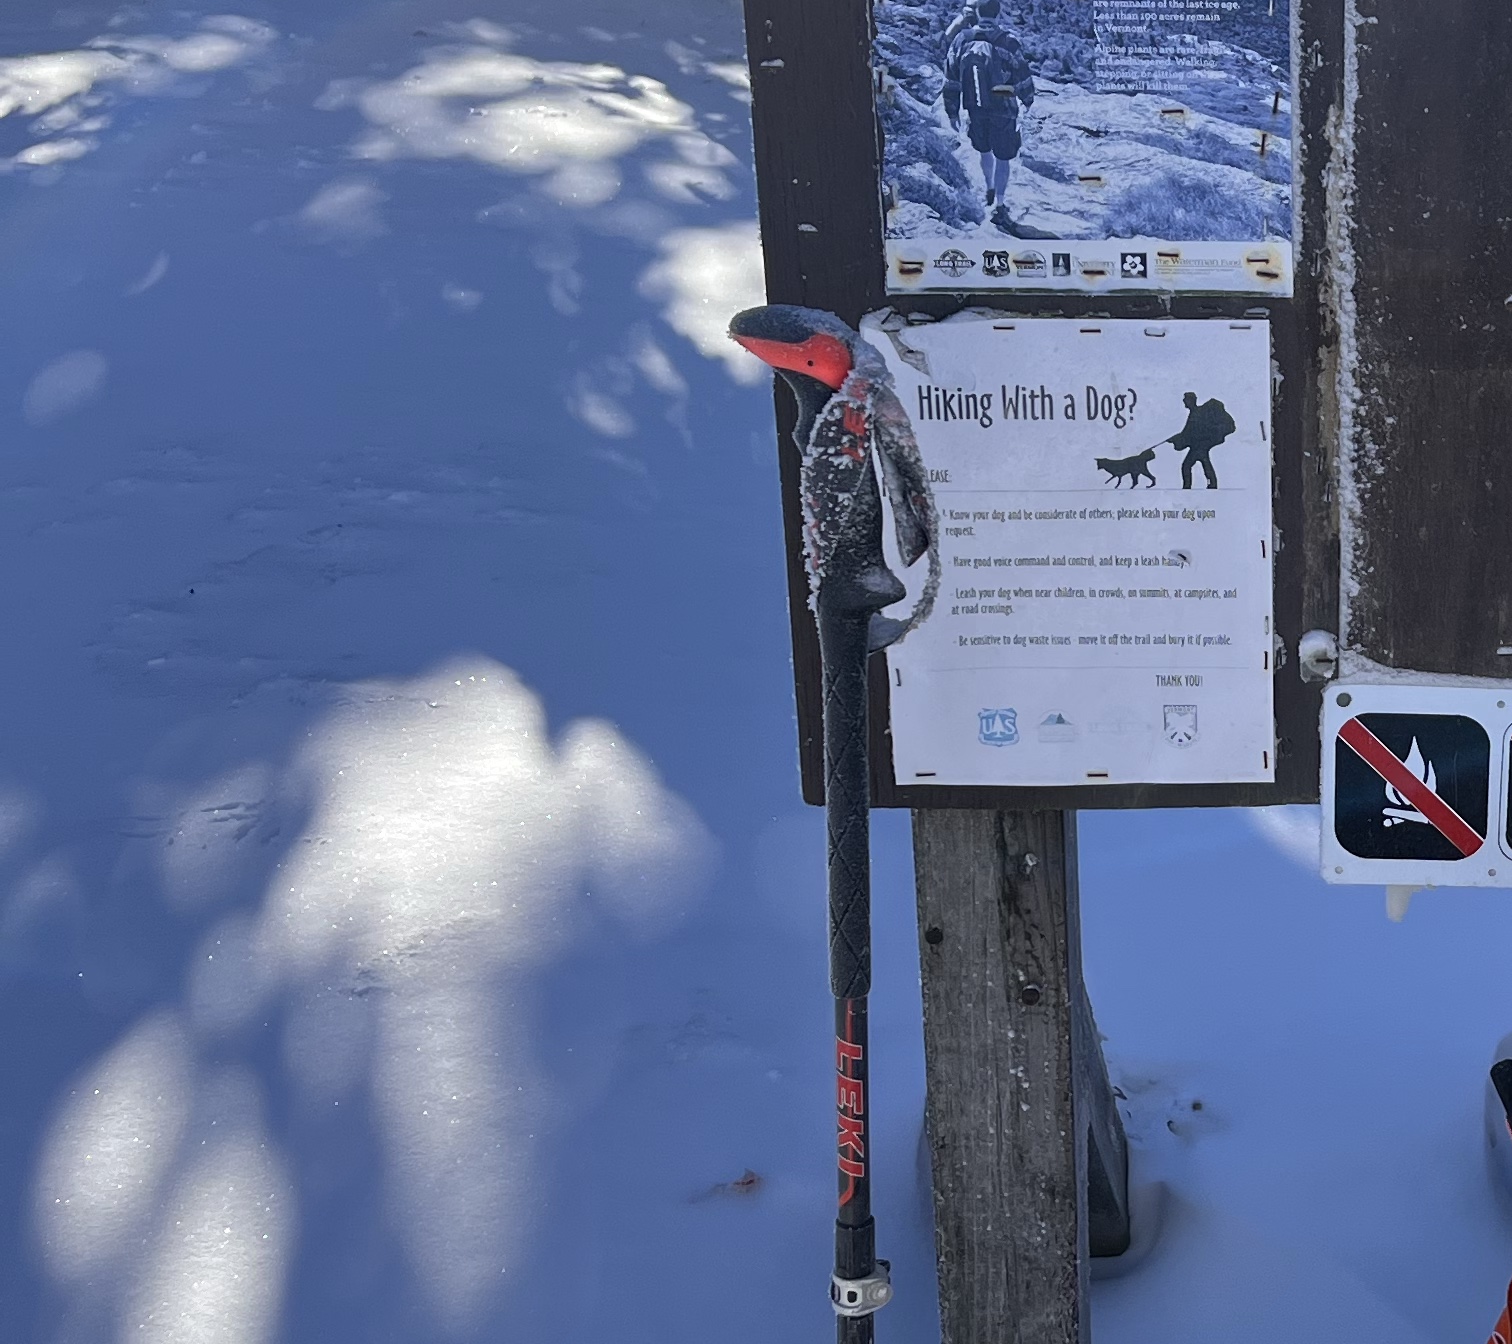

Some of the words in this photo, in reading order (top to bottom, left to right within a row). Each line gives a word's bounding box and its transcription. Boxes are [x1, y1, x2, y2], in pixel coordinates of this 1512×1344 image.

[1092, 0, 1109, 8] are
[1110, 0, 1155, 8] remnants
[1205, 0, 1219, 9] ice
[1221, 1, 1240, 11] age.
[1093, 11, 1115, 20] Less
[1117, 10, 1138, 20] than
[1140, 13, 1157, 21] 100
[1159, 12, 1184, 21] acres
[1186, 13, 1221, 21] remain
[918, 385, 993, 428] Hiking
[1001, 385, 1054, 421] With
[1064, 394, 1076, 421] a
[1086, 385, 1138, 429] Dog?
[949, 509, 970, 520] Know
[973, 511, 989, 522] your
[992, 509, 1006, 522] dog
[1008, 509, 1022, 520] and
[1023, 509, 1033, 520] be
[1034, 509, 1077, 520] considerate
[1079, 508, 1087, 519] of
[1117, 507, 1139, 520] please
[1141, 507, 1160, 519] leash
[1162, 510, 1179, 521] your
[1182, 508, 1195, 521] dog
[1197, 510, 1216, 521] upon
[945, 526, 976, 537] request.
[953, 556, 971, 567] Have
[973, 556, 992, 569] good
[993, 557, 1012, 566] voice
[1014, 555, 1050, 566] command
[1052, 555, 1066, 566] and
[1068, 555, 1097, 567] control,
[1099, 555, 1113, 566] and
[1115, 555, 1132, 568] keep
[1134, 557, 1139, 566] a
[1141, 555, 1159, 566] leash
[955, 587, 976, 599] Leash
[978, 589, 995, 600] your
[998, 587, 1012, 600] dog
[1013, 587, 1033, 597] when
[1035, 589, 1052, 597] near
[1054, 587, 1087, 599] children,
[1089, 587, 1097, 597] in
[1098, 587, 1125, 599] crowds,
[1128, 589, 1138, 598] on
[1139, 587, 1172, 599] summits,
[1174, 589, 1182, 598] at
[1184, 588, 1221, 600] campsites,
[1223, 588, 1237, 598] and
[951, 605, 960, 615] at
[961, 603, 979, 615] road
[981, 603, 1015, 616] crossings.
[959, 635, 968, 646] Be
[970, 635, 1001, 646] sensitive
[1003, 635, 1011, 645] to
[1013, 634, 1027, 647] dog
[1029, 635, 1050, 645] waste
[1051, 634, 1071, 645] issues
[1079, 636, 1098, 645] move
[1100, 634, 1107, 645] it
[1108, 634, 1119, 645] off
[1120, 634, 1132, 645] the
[1135, 634, 1150, 645] trail
[1153, 634, 1167, 645] and
[1169, 634, 1185, 647] bury
[1187, 634, 1194, 645] it
[1196, 634, 1202, 645] if
[1203, 634, 1232, 647] possible.
[1155, 675, 1182, 687] THANK
[1185, 675, 1203, 687] YOU!
[835, 1035, 865, 1178] LEKI
